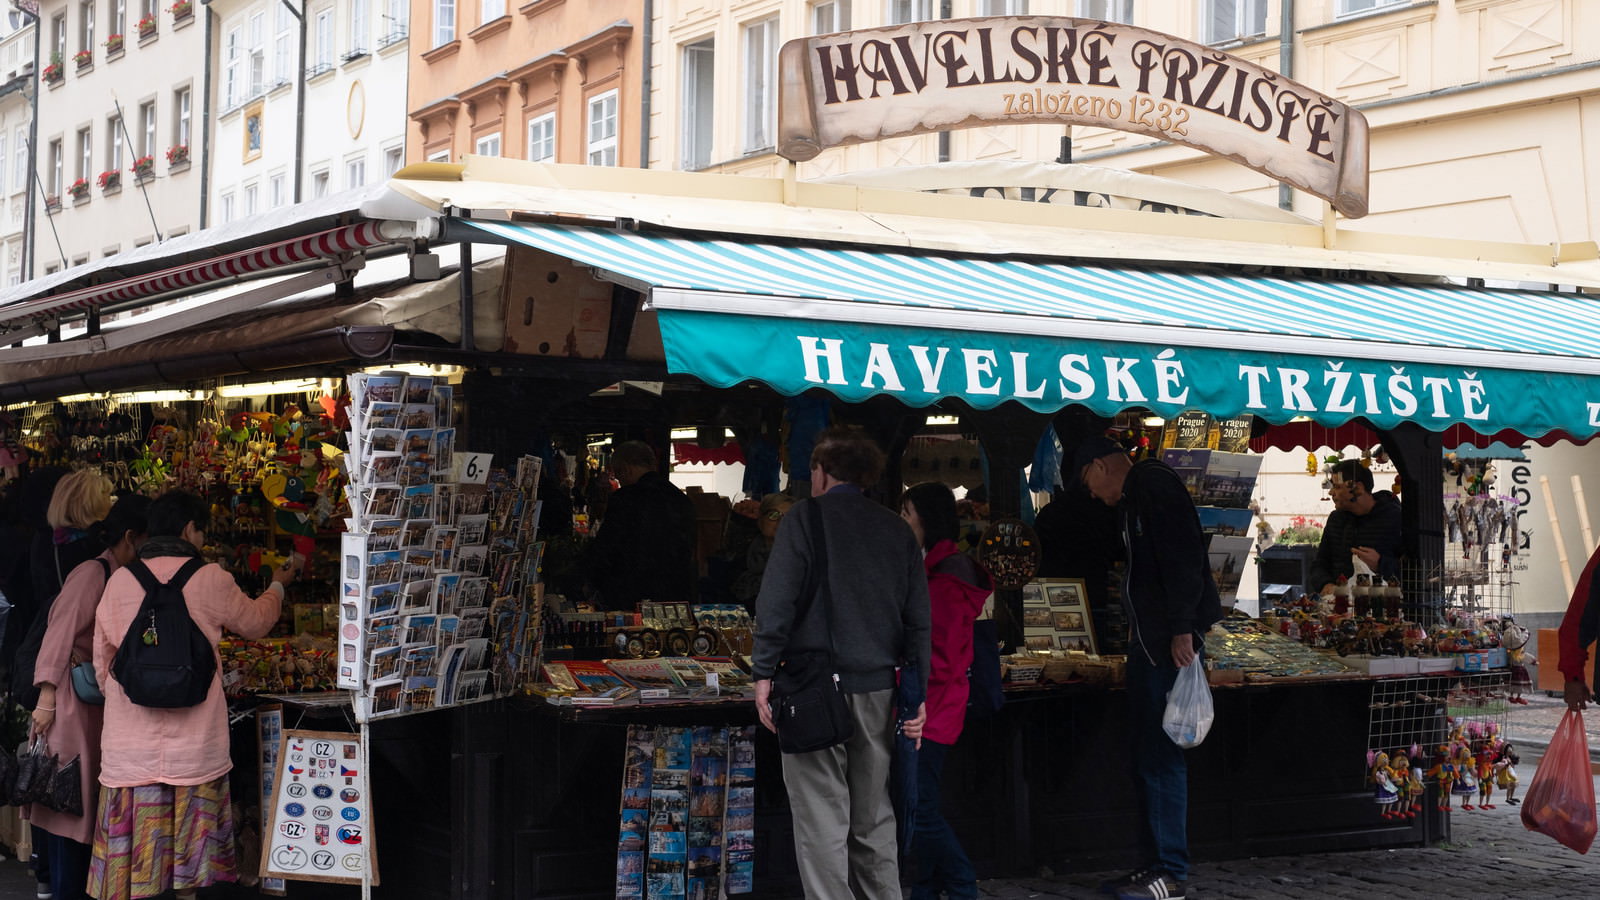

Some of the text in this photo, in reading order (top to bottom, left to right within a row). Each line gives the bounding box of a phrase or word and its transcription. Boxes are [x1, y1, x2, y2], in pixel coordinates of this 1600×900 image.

[816, 22, 1340, 163] HAVELSKÉ TRŽIŠTĚ
[1003, 88, 1191, 137] založeno 1232
[797, 336, 1491, 421] HAVELSKÉ TRŽIŠTĚ
[1177, 416, 1206, 427] Prague
[1180, 428, 1199, 437] 2020
[1223, 429, 1243, 438] 2020
[316, 743, 330, 756] CZ
[289, 786, 303, 796] CZ
[286, 824, 301, 837] CZ
[342, 829, 361, 841] CZ
[277, 850, 300, 867] CZ
[314, 854, 333, 866] CZ
[344, 857, 361, 868] CZ
